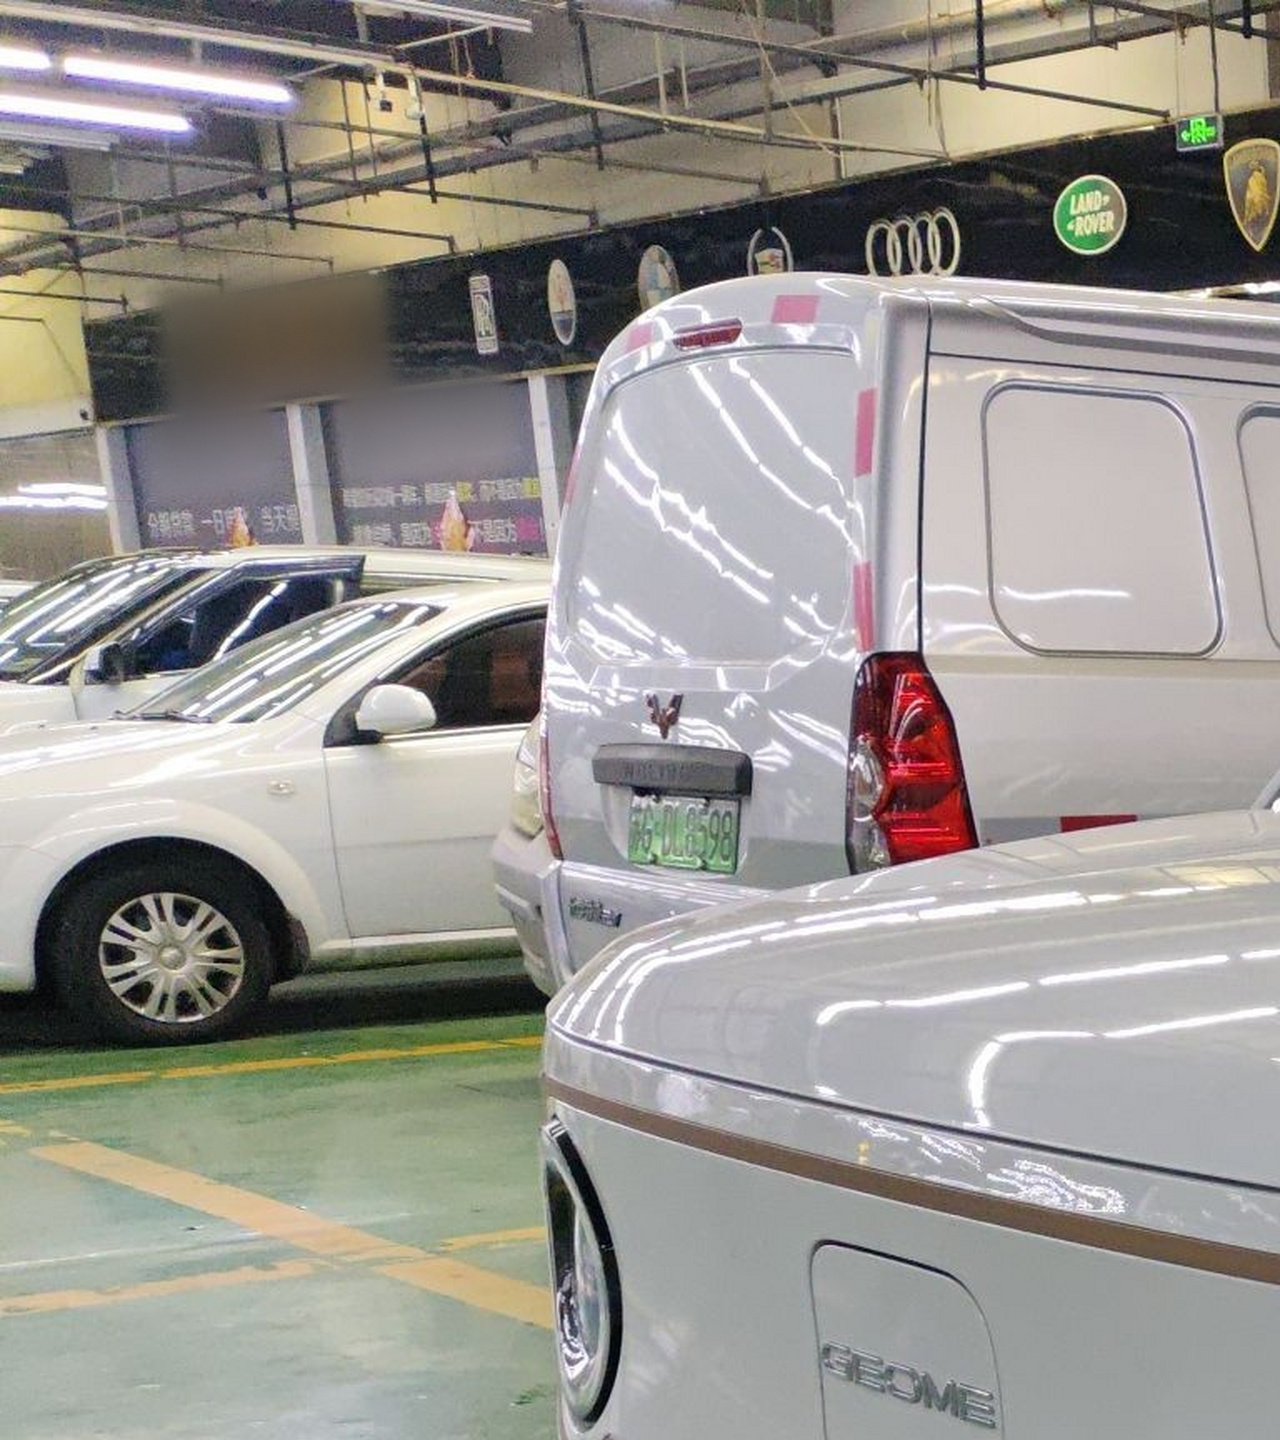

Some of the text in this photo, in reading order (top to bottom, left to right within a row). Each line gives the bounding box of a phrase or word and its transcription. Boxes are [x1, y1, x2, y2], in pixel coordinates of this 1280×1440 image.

[1069, 190, 1102, 216] LAND
[1073, 210, 1115, 237] ROVER
[821, 1339, 997, 1430] GEOME
